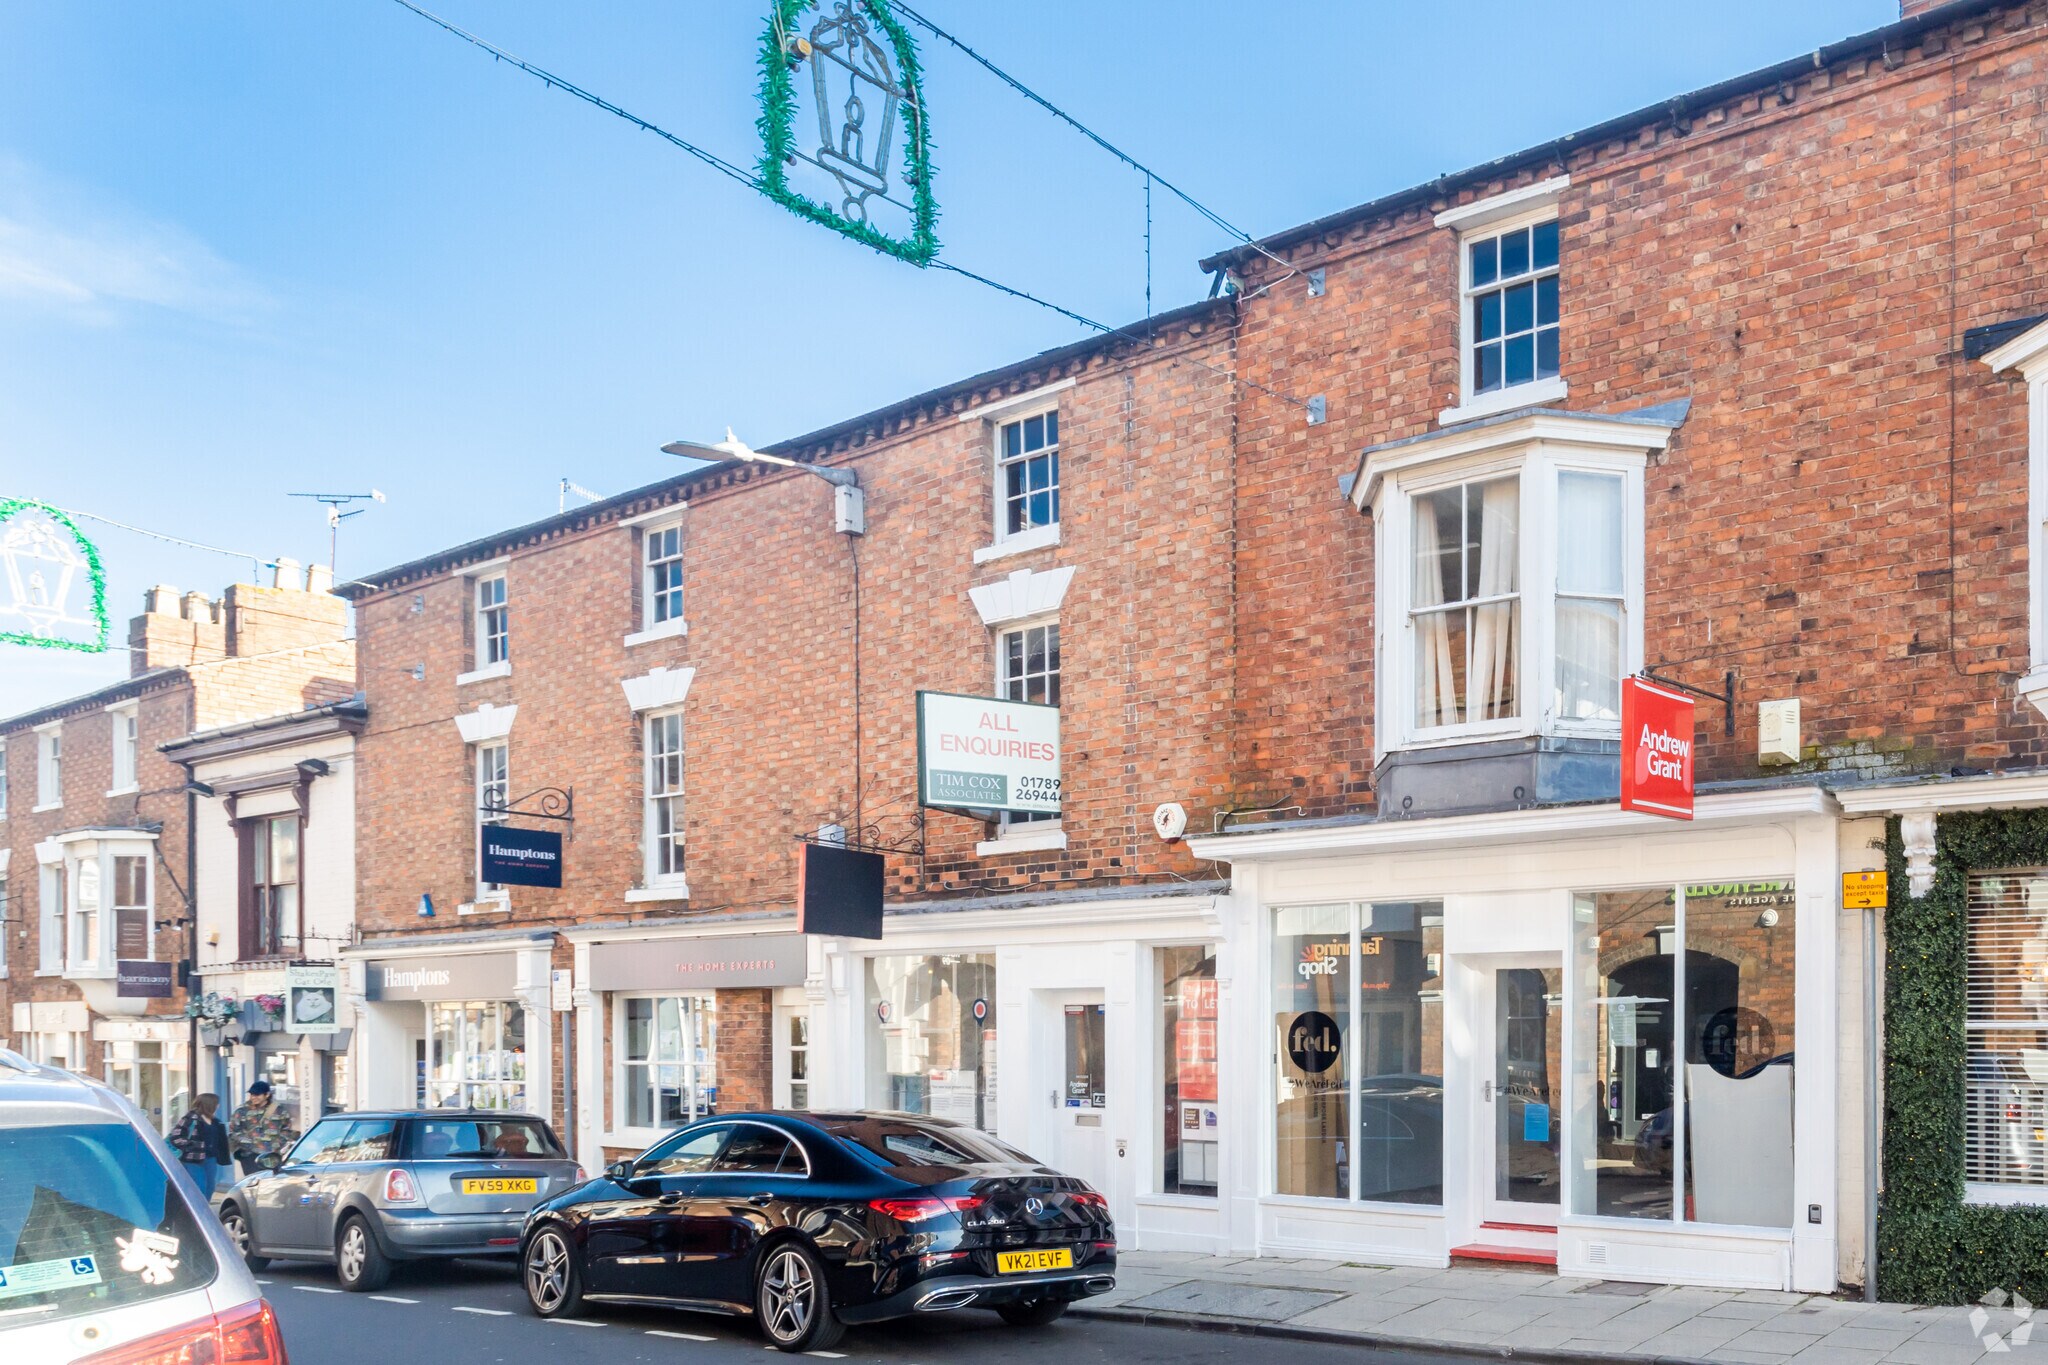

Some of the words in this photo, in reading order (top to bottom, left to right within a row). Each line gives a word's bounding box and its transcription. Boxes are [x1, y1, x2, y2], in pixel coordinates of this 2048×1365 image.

[978, 711, 1019, 733] ALL
[940, 733, 1055, 761] ENQUIRIES
[1639, 723, 1690, 758] Andrew
[1647, 750, 1682, 781] Grant
[936, 773, 965, 788] TIM
[968, 775, 1001, 791] COX
[1021, 776, 1061, 791] 01789
[937, 787, 1002, 801] ASSOCIATES
[488, 844, 556, 860] Hamptons
[1845, 890, 1867, 898] except
[1857, 883, 1885, 891] stopping
[676, 963, 694, 973] THE
[698, 962, 727, 972] HOME
[730, 960, 776, 971] EXPERTS
[384, 967, 450, 992] Hamptons
[1185, 999, 1198, 1009] TO
[1292, 1026, 1337, 1052] fed.
[1069, 1080, 1089, 1088] Andrew
[469, 1181, 503, 1191] FV59
[507, 1181, 531, 1190] XKG
[1006, 1254, 1036, 1270] VK21
[1040, 1252, 1062, 1267] EVF
